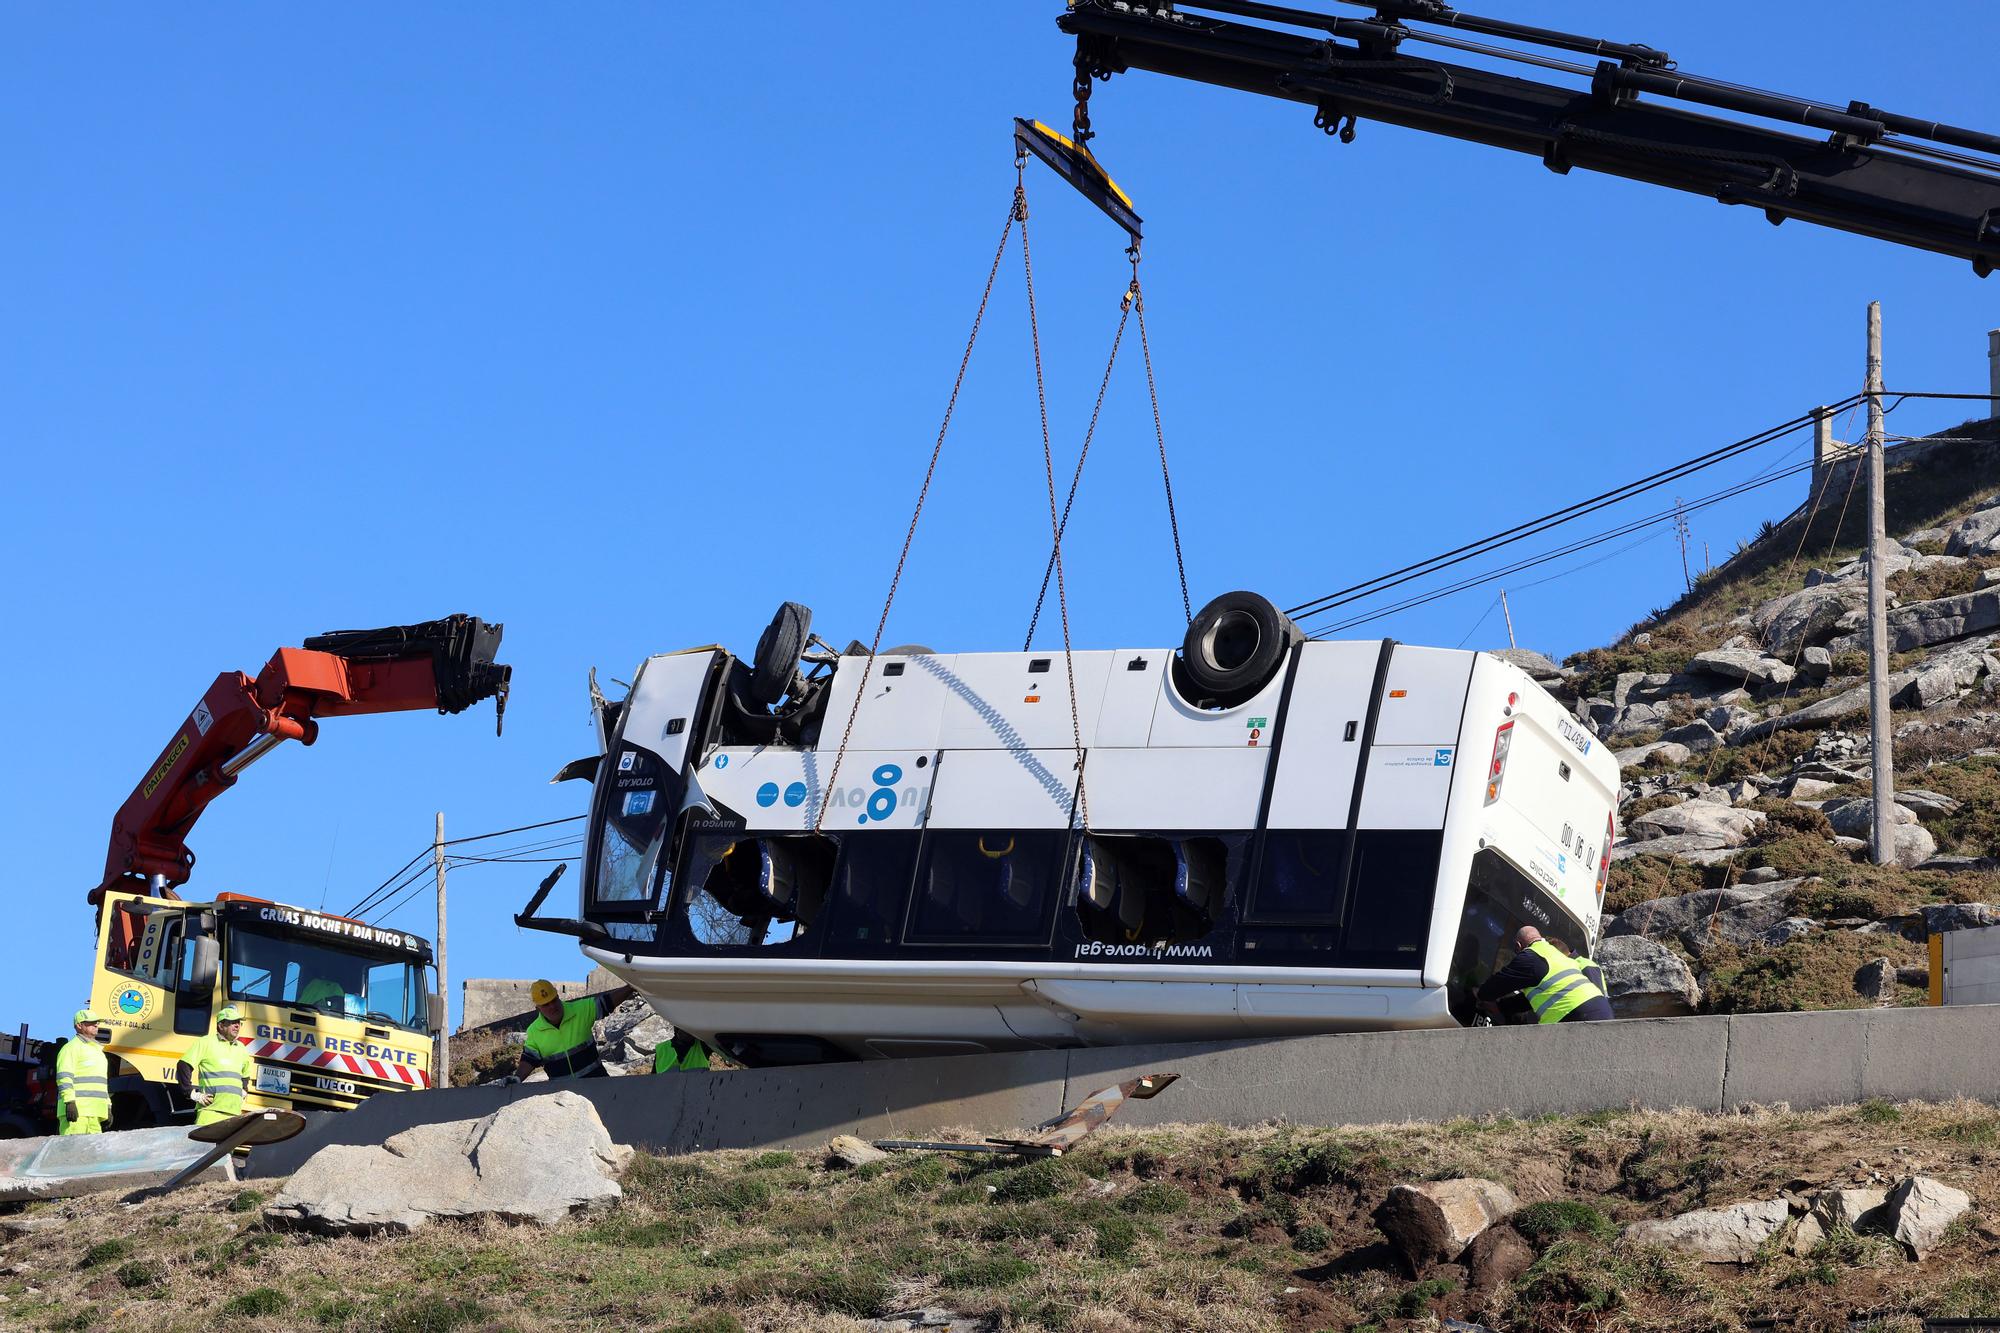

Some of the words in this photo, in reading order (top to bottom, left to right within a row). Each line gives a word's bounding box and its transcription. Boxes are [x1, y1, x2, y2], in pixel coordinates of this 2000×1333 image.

[145, 738, 187, 795] PALFINGER
[618, 777, 654, 788] OTOKAR
[692, 819, 700, 828] U
[702, 819, 737, 828] NAVIGO
[1561, 823, 1573, 849] 100
[1574, 835, 1585, 859] 90
[1586, 847, 1596, 871] 70
[303, 914, 341, 934] NOCHE
[344, 921, 352, 936] Y
[353, 924, 373, 942] DIA
[374, 929, 402, 947] VIGO
[256, 1024, 317, 1047] GRÚA
[325, 1036, 418, 1066] RESCATE
[263, 1067, 286, 1079] AUXILIO
[316, 1076, 355, 1094] IVECO
